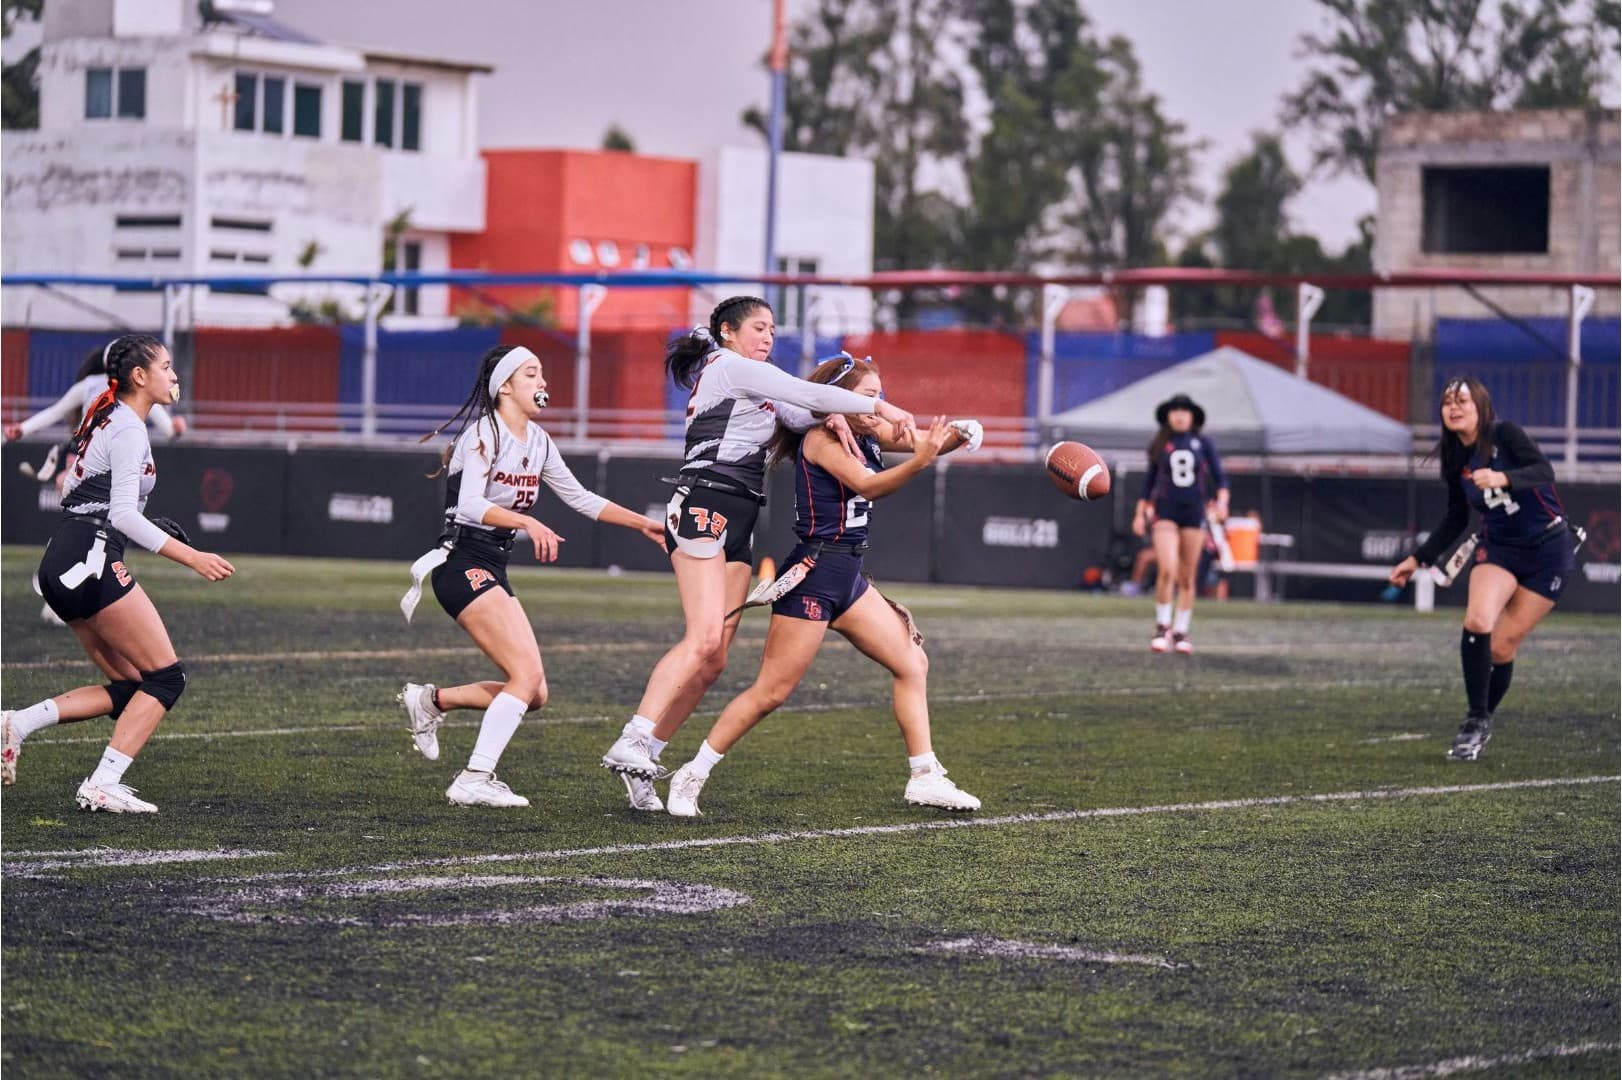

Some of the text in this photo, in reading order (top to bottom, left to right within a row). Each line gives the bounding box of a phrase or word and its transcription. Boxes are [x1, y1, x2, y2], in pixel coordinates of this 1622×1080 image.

[1170, 449, 1195, 487] 8
[511, 490, 534, 511] 25
[689, 507, 727, 537] 72
